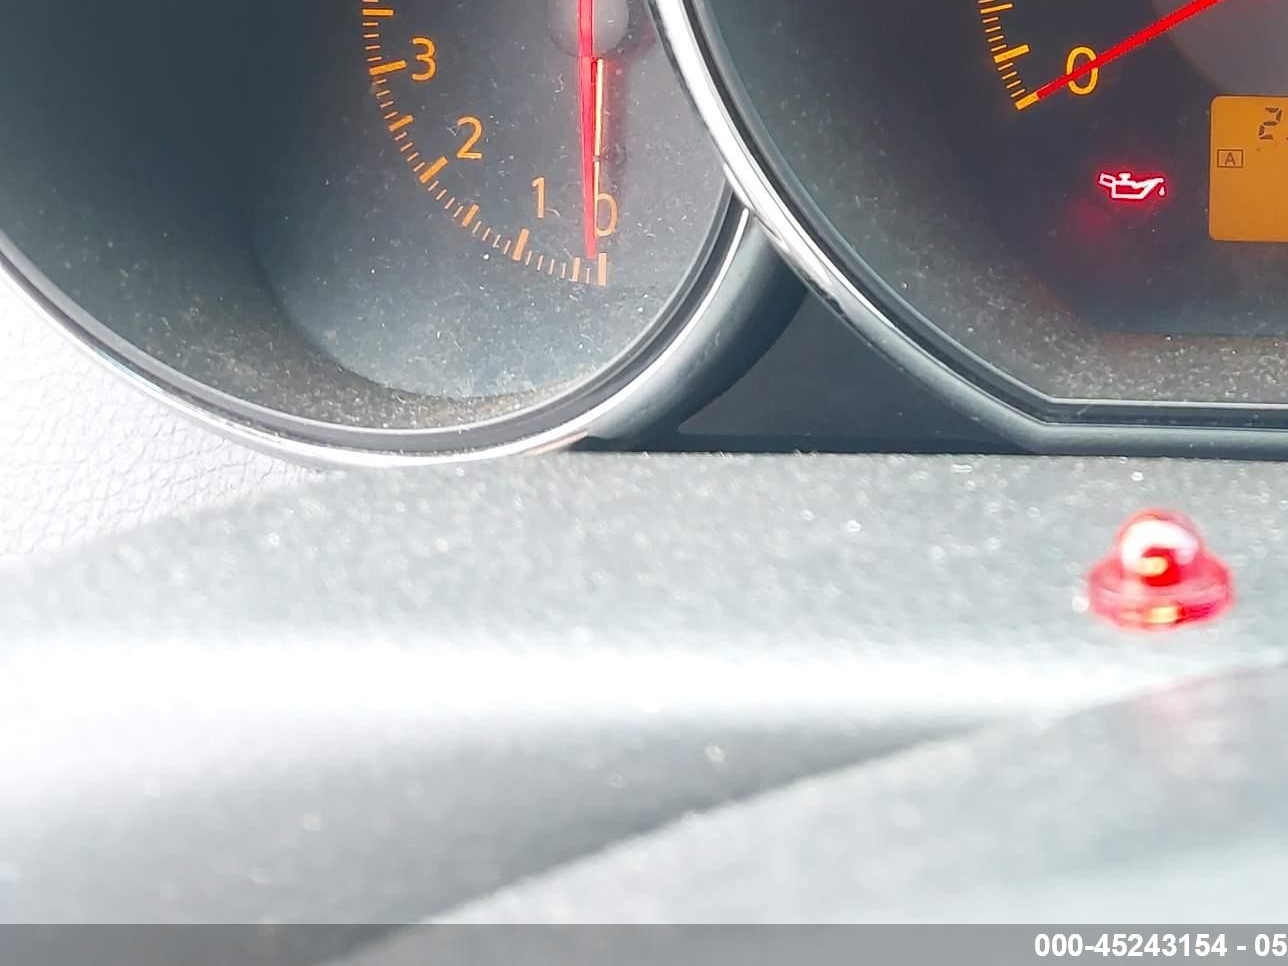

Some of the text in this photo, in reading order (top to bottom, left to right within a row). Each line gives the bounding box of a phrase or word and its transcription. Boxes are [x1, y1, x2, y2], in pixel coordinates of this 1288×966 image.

[411, 37, 437, 81] 3
[1065, 46, 1100, 96] 0
[456, 115, 483, 160] 2
[1224, 152, 1236, 166] A
[532, 177, 546, 219] 1
[594, 193, 619, 238] 0
